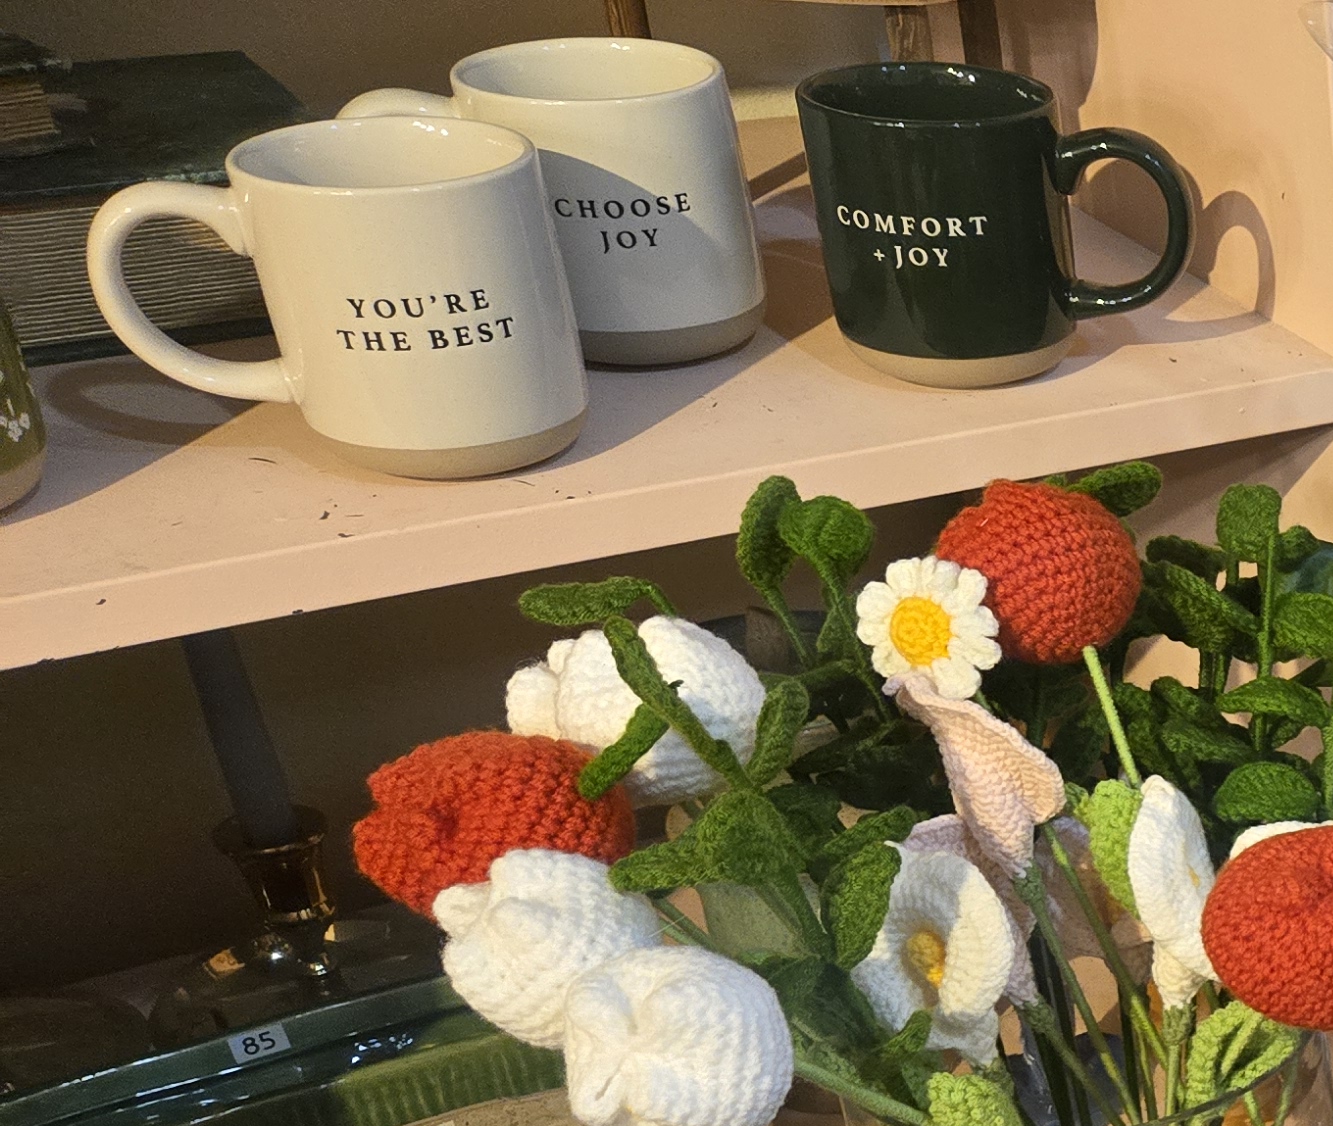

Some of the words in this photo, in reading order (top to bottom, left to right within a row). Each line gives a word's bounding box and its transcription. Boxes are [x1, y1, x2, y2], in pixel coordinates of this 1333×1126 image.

[554, 192, 691, 220] CHOOSE
[836, 205, 988, 237] COMFORT
[600, 228, 659, 254] JOY
[873, 249, 886, 262] +
[893, 245, 949, 269] JOY
[346, 289, 490, 319] YOU'RE
[336, 329, 412, 352] THE
[427, 317, 514, 350] BEST
[241, 1030, 277, 1055] 85
